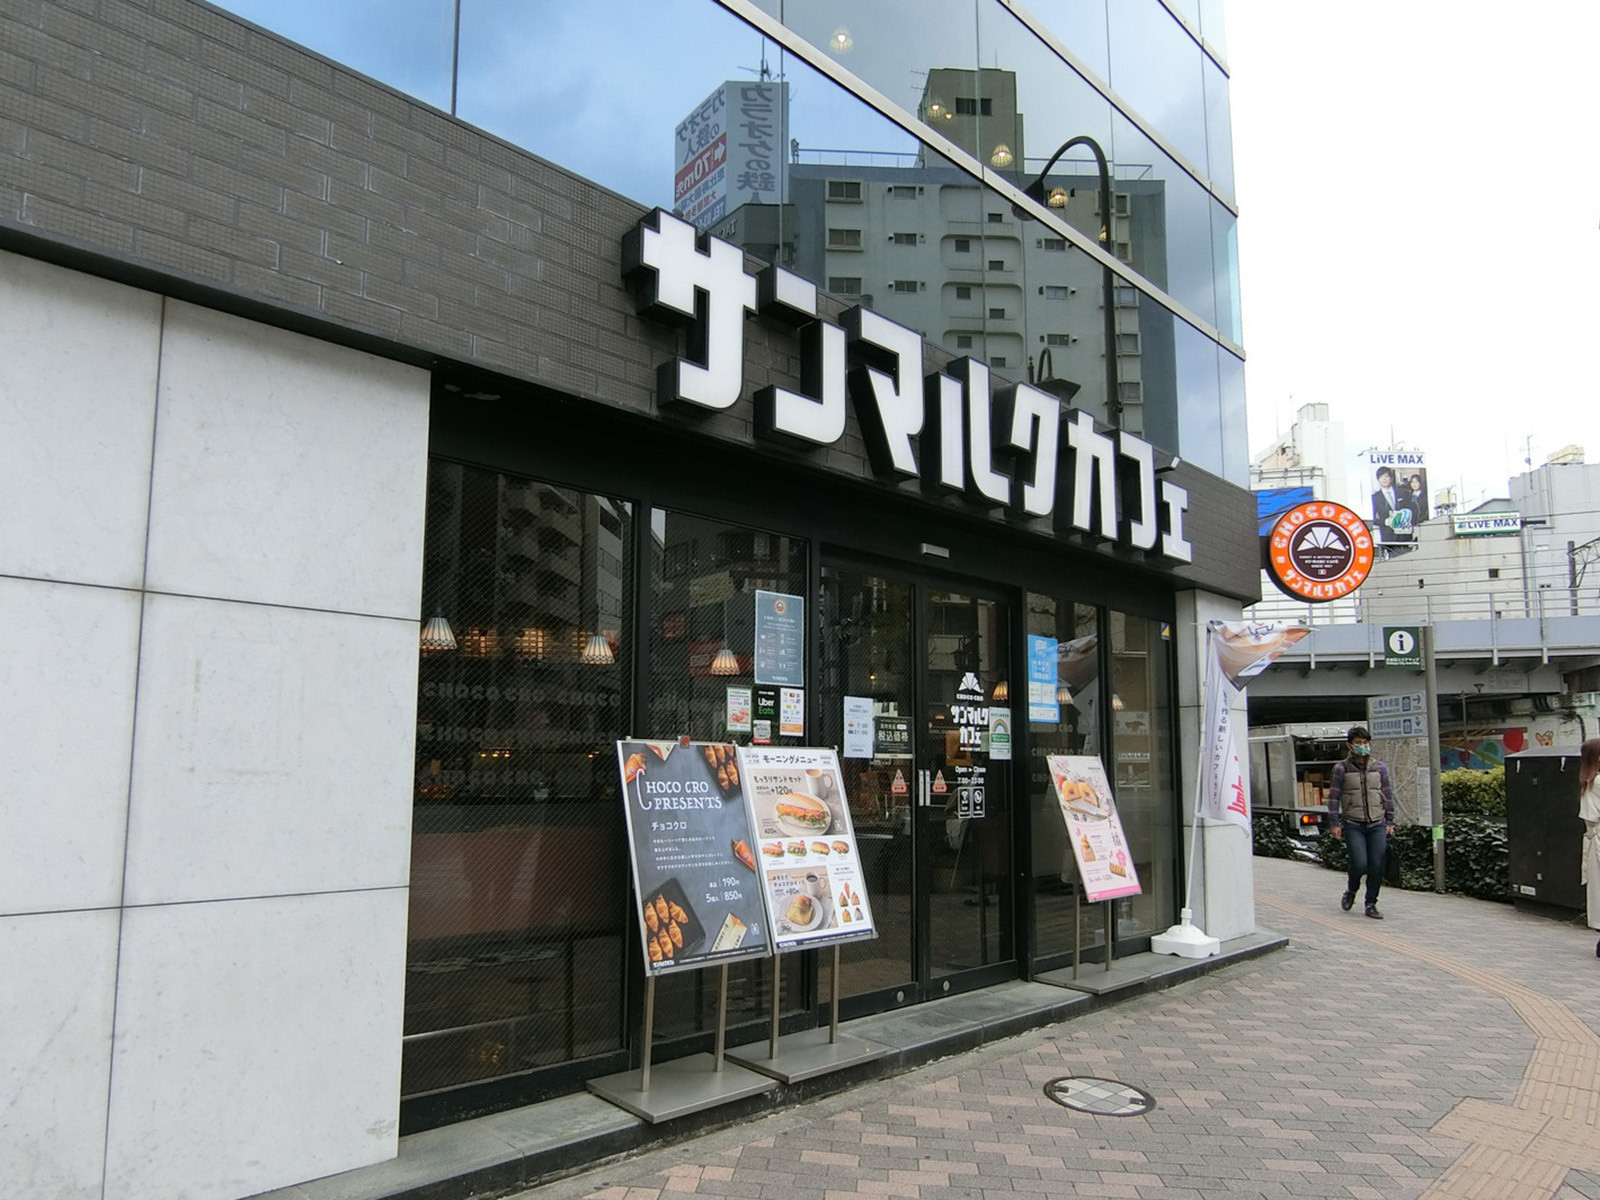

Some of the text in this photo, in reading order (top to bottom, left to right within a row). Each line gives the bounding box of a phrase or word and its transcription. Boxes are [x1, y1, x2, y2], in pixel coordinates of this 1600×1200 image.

[641, 208, 1192, 565] サンマルクカフェ
[1397, 453, 1424, 464] MAX
[1273, 505, 1370, 549] CHOCO CRO
[1493, 518, 1518, 528] MAX
[1283, 569, 1364, 597] サンマルクカフェ
[758, 697, 775, 707] Uber
[758, 706, 775, 715] Eats
[950, 705, 989, 726] サンマルク
[877, 730, 909, 742] 税込価格
[959, 726, 982, 745] カフェ
[762, 754, 818, 765] モーニングメニュー
[635, 768, 709, 810] CHOCO CRO
[653, 796, 723, 810] PRESENTS
[651, 820, 687, 831] チョコクロ
